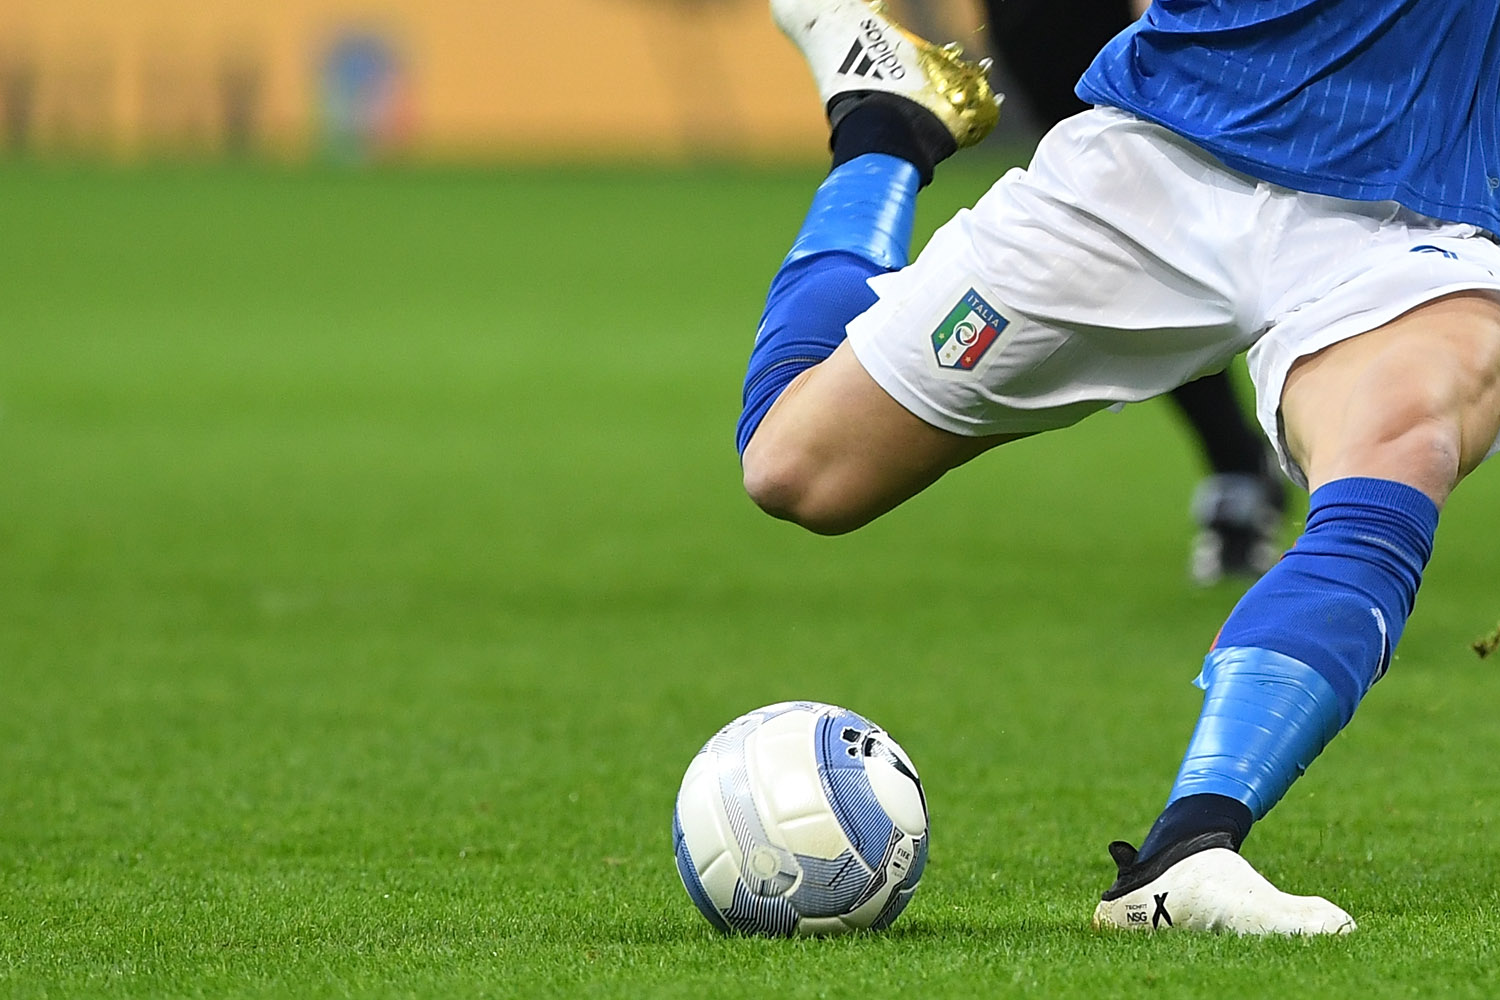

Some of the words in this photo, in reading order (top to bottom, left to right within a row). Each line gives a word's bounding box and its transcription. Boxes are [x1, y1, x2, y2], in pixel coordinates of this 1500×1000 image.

[860, 19, 906, 80] adidas
[967, 294, 1000, 328] ITALIA
[1127, 911, 1148, 922] NSG
